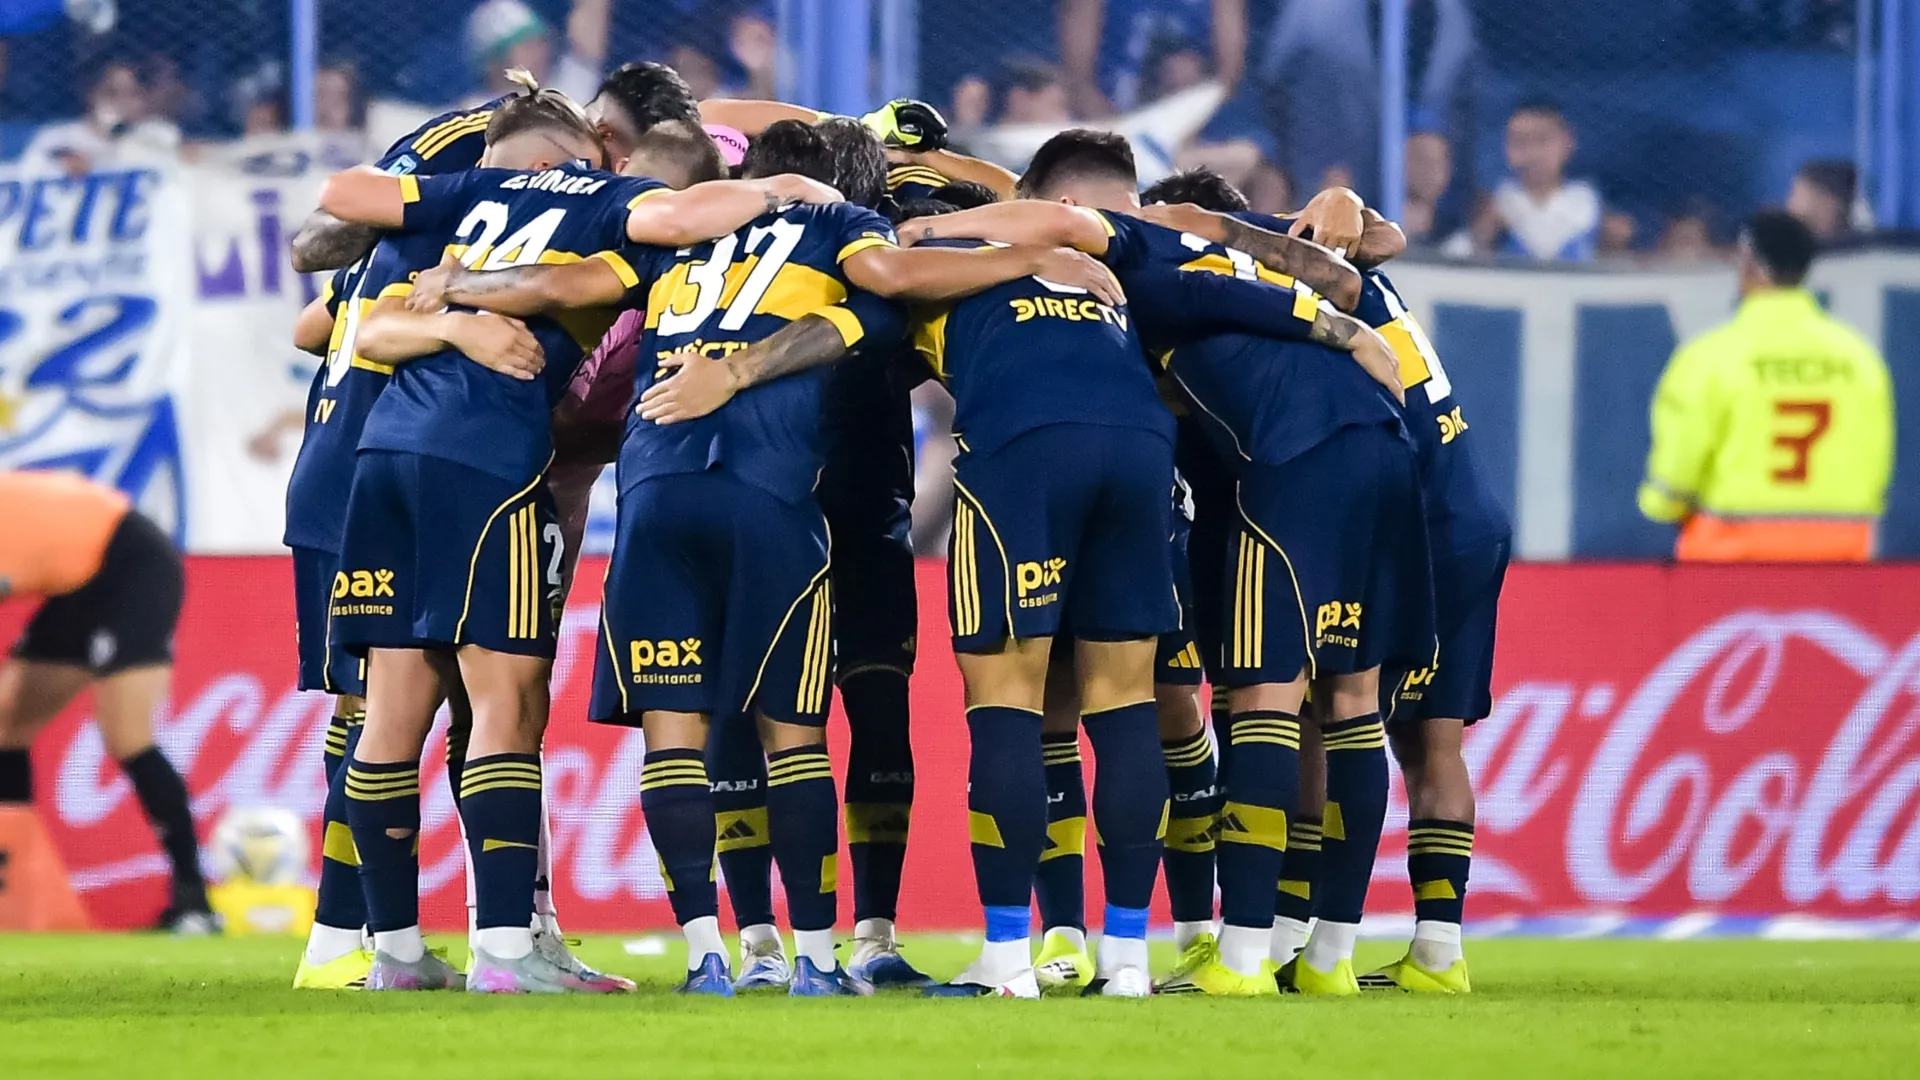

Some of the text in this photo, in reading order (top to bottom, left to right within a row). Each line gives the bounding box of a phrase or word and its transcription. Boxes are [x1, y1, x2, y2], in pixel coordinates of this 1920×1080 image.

[455, 200, 567, 271] 24
[657, 217, 806, 336] 37
[1010, 296, 1127, 332] DIRECTV
[1772, 400, 1832, 482] 3
[1316, 600, 1363, 639] pax
[630, 637, 702, 673] pax
[633, 673, 702, 685] assistance
